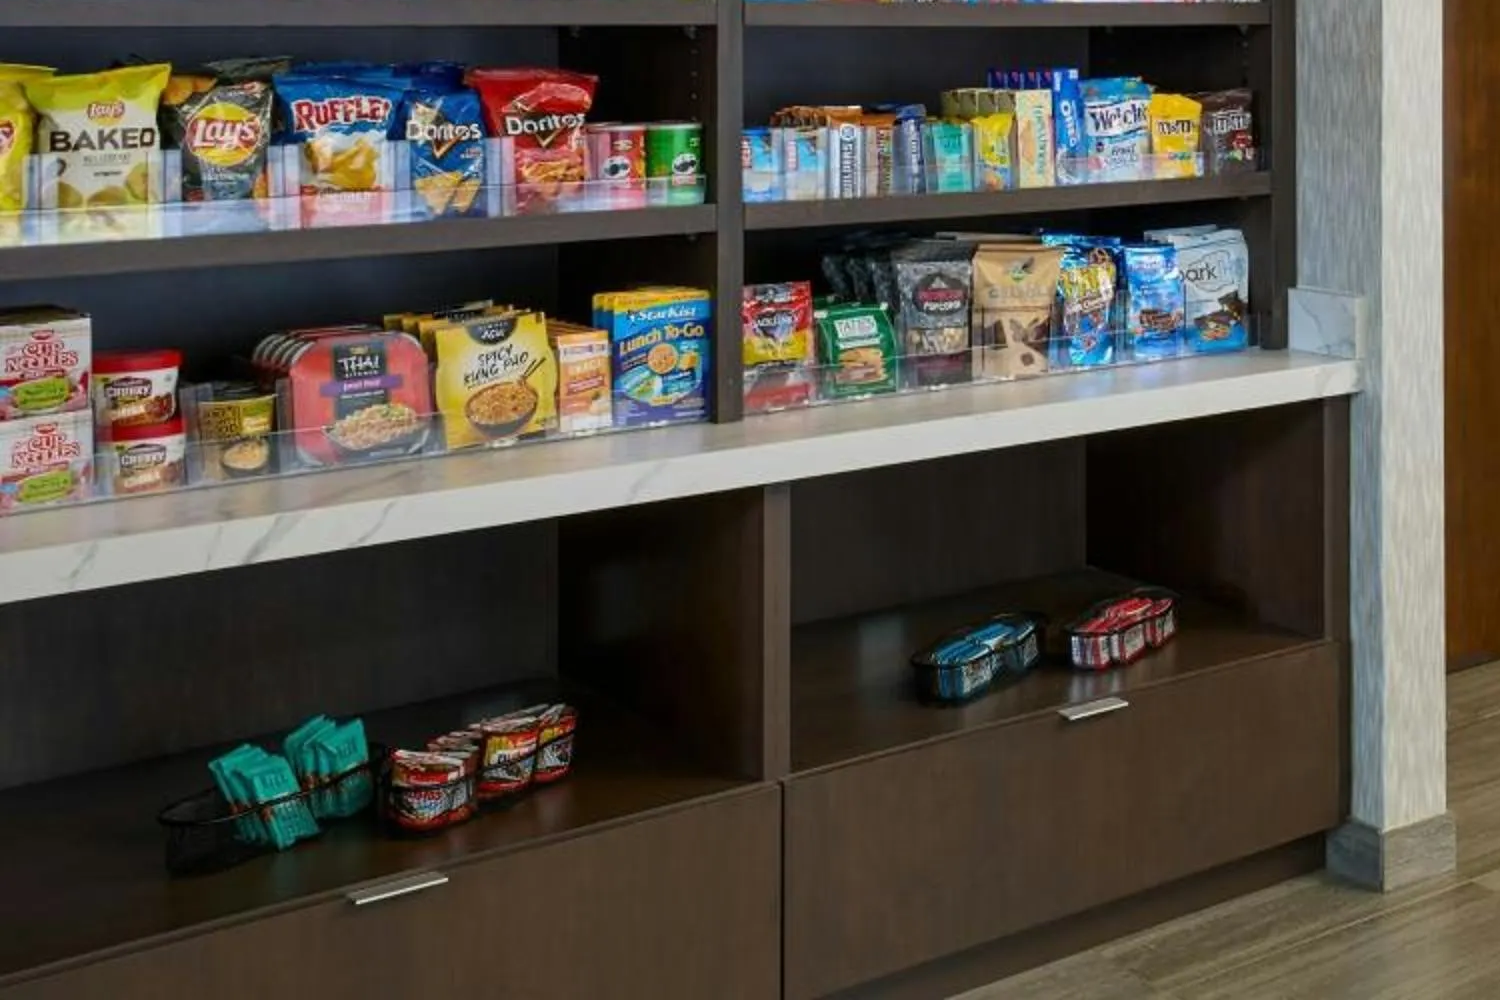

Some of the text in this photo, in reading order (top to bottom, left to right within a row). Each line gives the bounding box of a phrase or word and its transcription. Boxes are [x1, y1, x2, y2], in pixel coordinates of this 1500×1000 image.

[193, 117, 258, 150] Lay's
[405, 120, 482, 141] Doritos
[505, 112, 586, 136] Doritos
[50, 127, 156, 152] BAKED
[619, 331, 662, 355] Lunch
[5, 352, 79, 375] NOODLES
[336, 355, 381, 372] THAI
[476, 343, 514, 368] SPICY
[463, 365, 500, 387] KUNG
